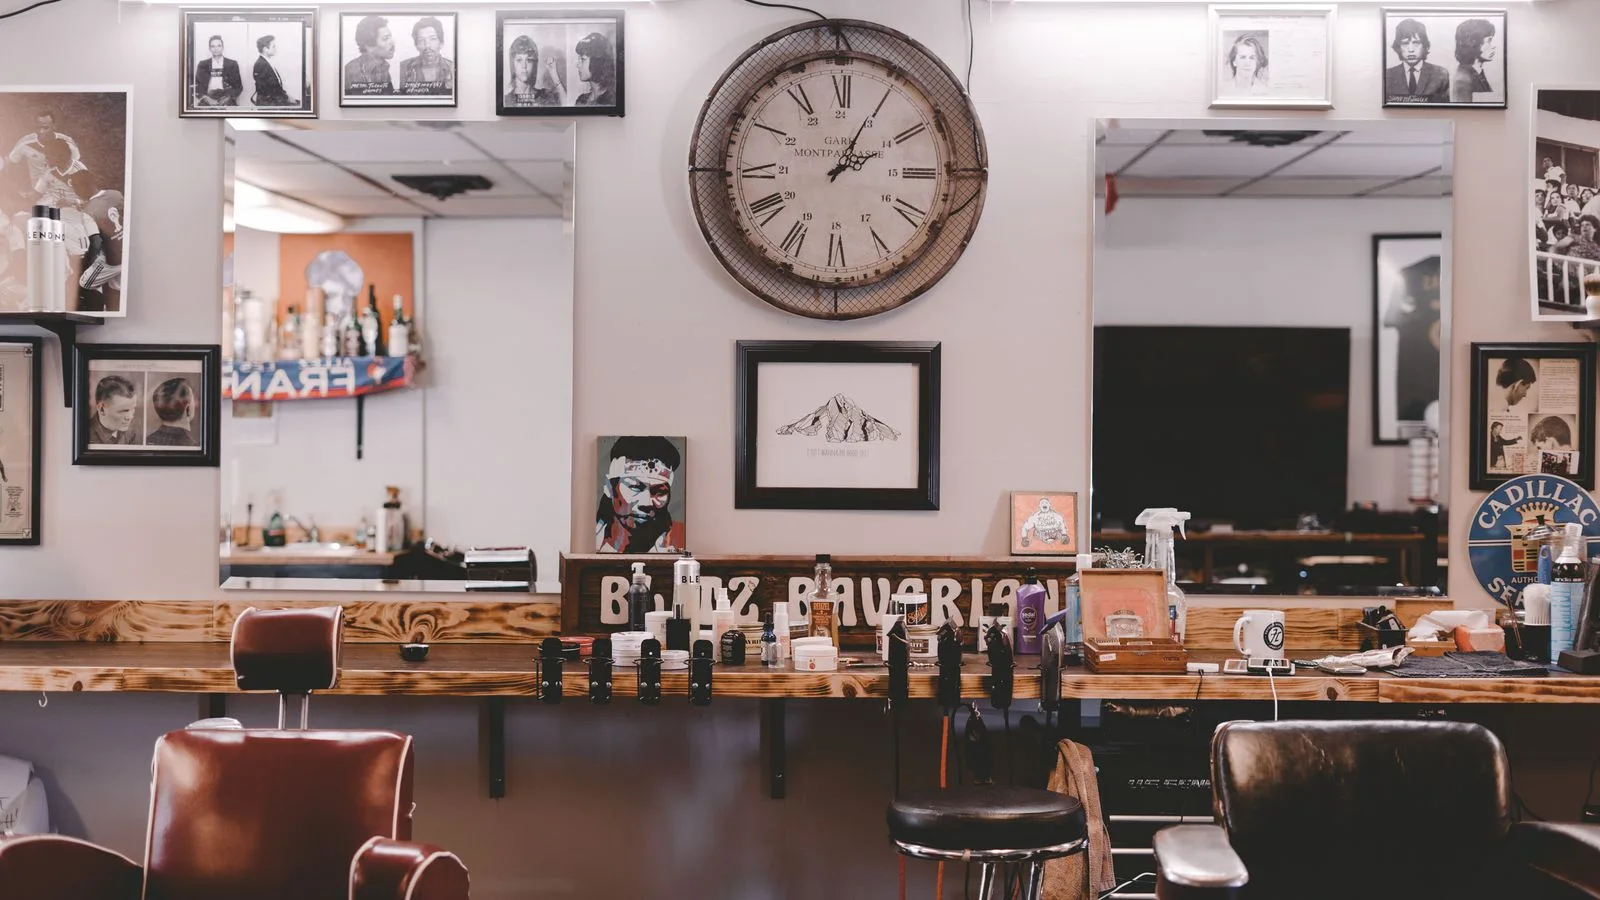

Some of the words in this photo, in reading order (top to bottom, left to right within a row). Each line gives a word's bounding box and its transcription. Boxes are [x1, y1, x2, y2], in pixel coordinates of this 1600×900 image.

[835, 110, 846, 119] 24
[807, 117, 819, 127] 23
[785, 136, 797, 146] 22
[881, 139, 892, 149] 14
[778, 165, 789, 175] 21
[887, 168, 898, 177] 15
[784, 190, 796, 200] 20
[880, 194, 892, 203] 16
[802, 212, 813, 222] 19
[860, 213, 871, 223] 17
[831, 221, 842, 231] 18
[1477, 479, 1598, 529] CADILLAC
[600, 575, 761, 626] BTZ
